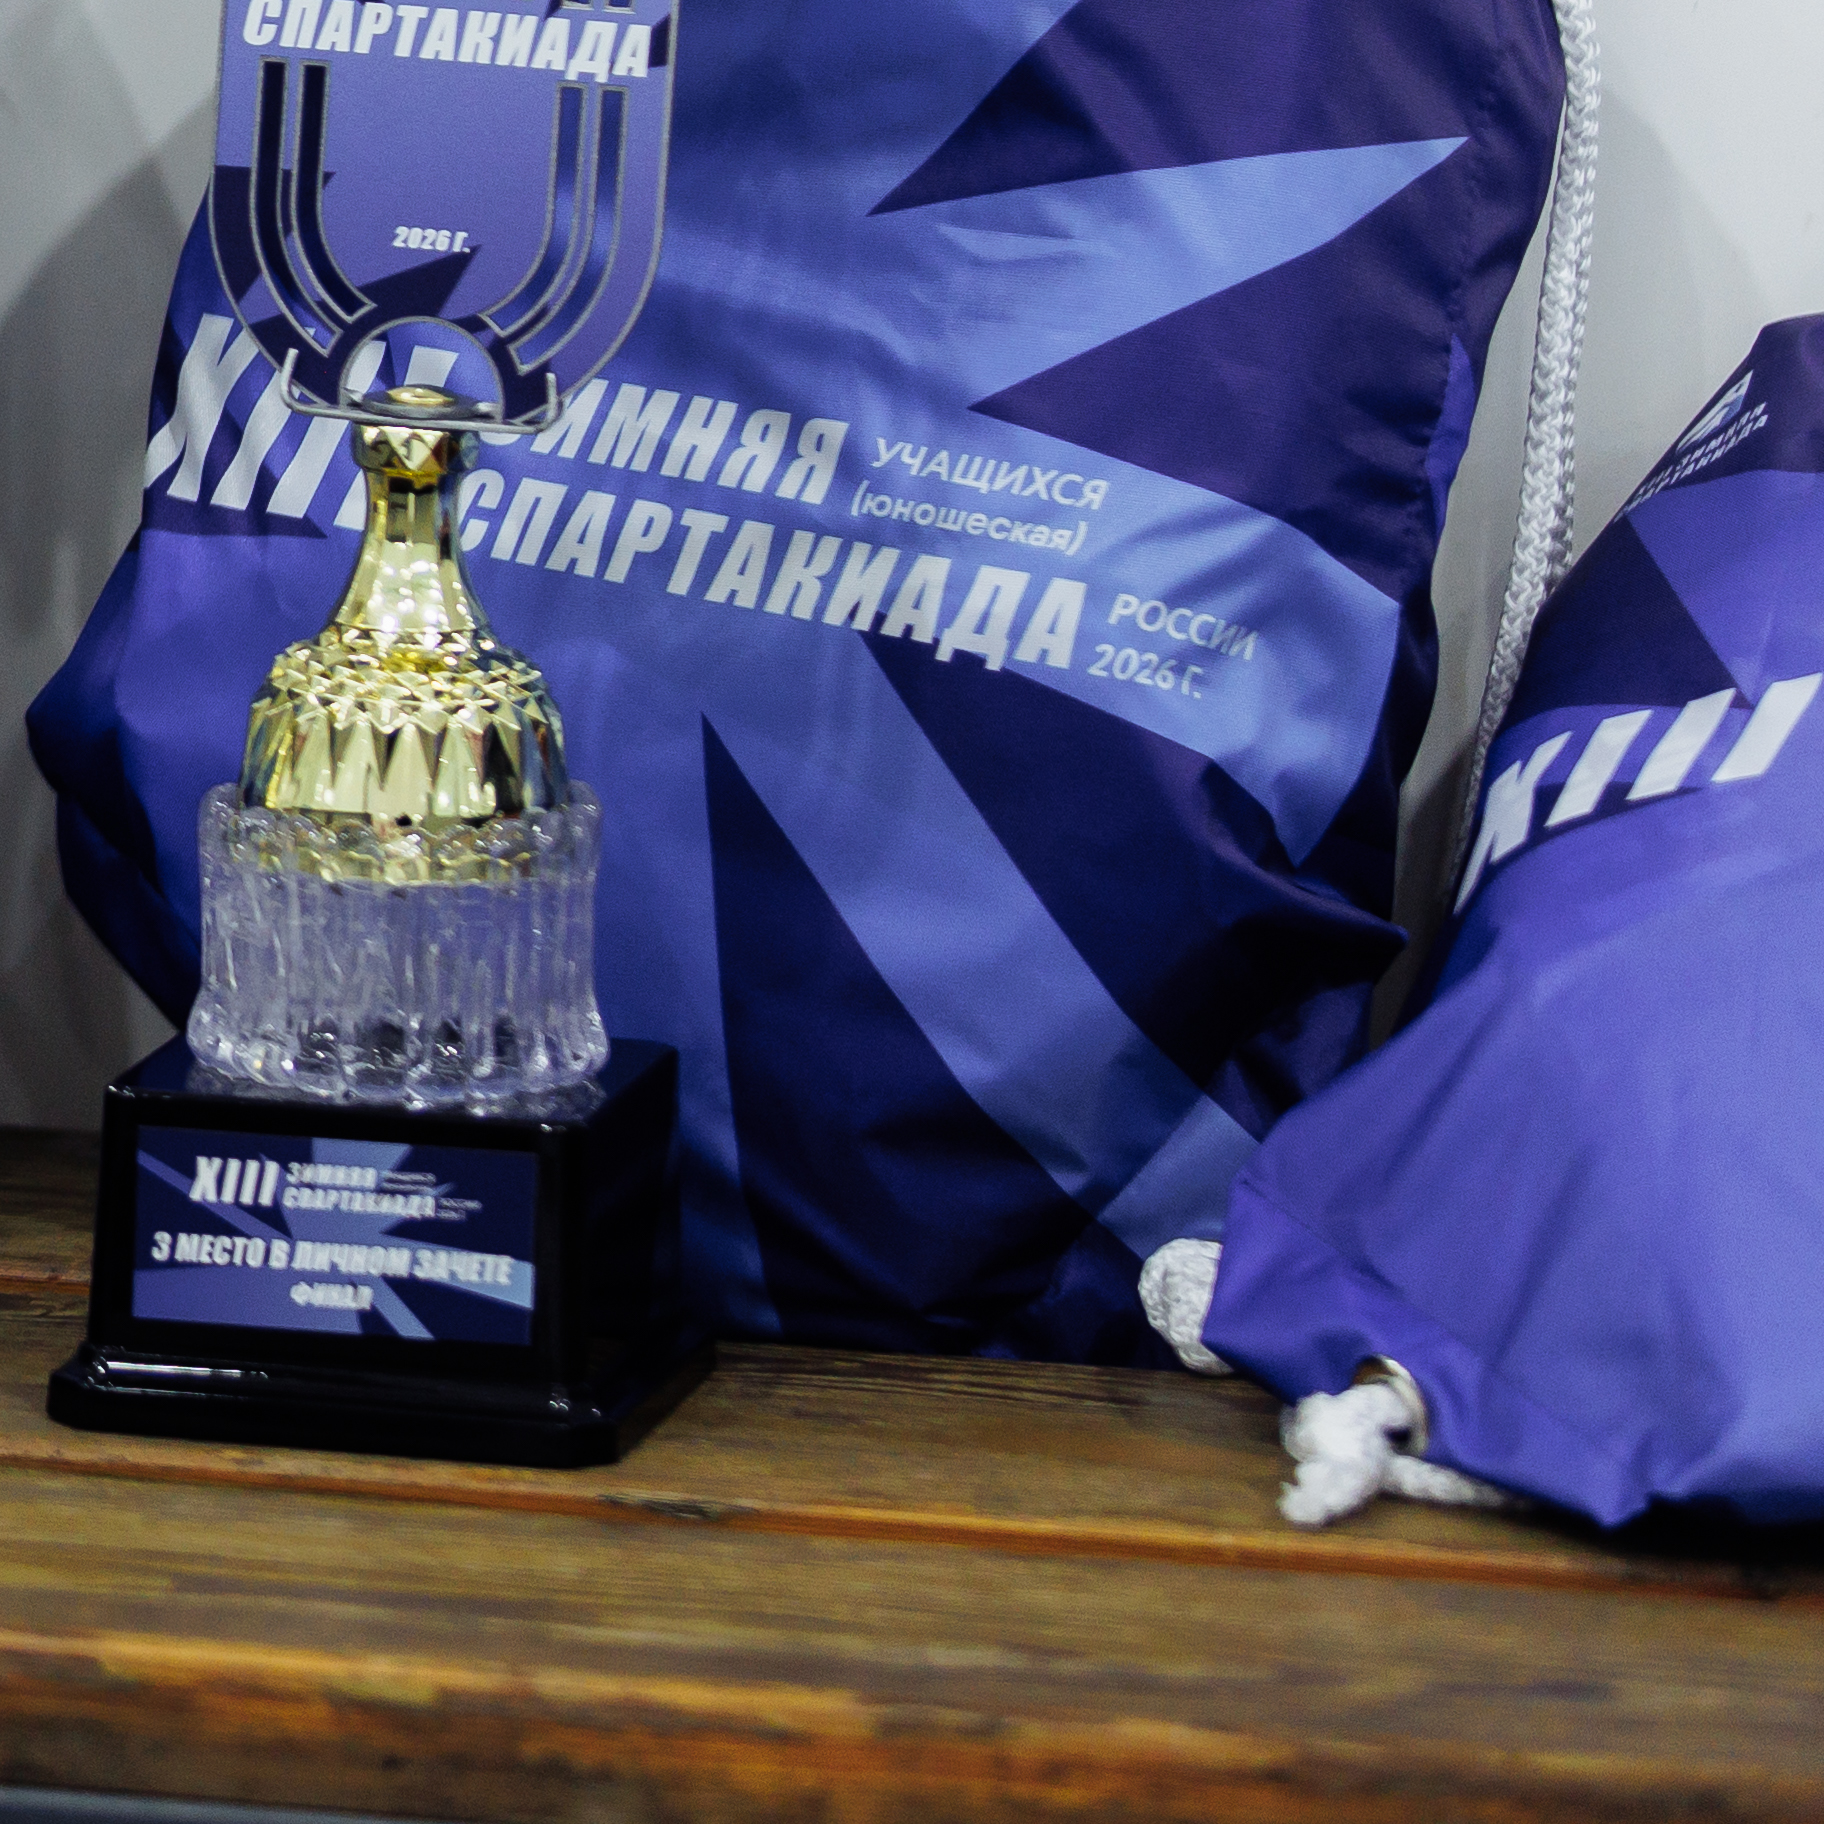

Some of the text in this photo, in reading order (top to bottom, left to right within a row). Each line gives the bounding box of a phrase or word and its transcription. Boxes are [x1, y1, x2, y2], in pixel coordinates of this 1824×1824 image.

[392, 225, 451, 251] 2026
[479, 378, 850, 505] ИМНЯЯ
[870, 436, 1109, 510] УЧАЩИХСЯ
[851, 480, 1089, 555] (юношеская)
[456, 468, 1087, 671] СПАРТАКИАДА
[1108, 593, 1259, 661] РОССИИ
[1087, 643, 1174, 691] 2026
[1454, 673, 1823, 916] XIII
[189, 1156, 280, 1207] XIII
[174, 1233, 266, 1267] МЕСТО
[292, 1241, 410, 1277] ЛИЧНОМ
[413, 1248, 515, 1286] ЗАЧЕТЕ
